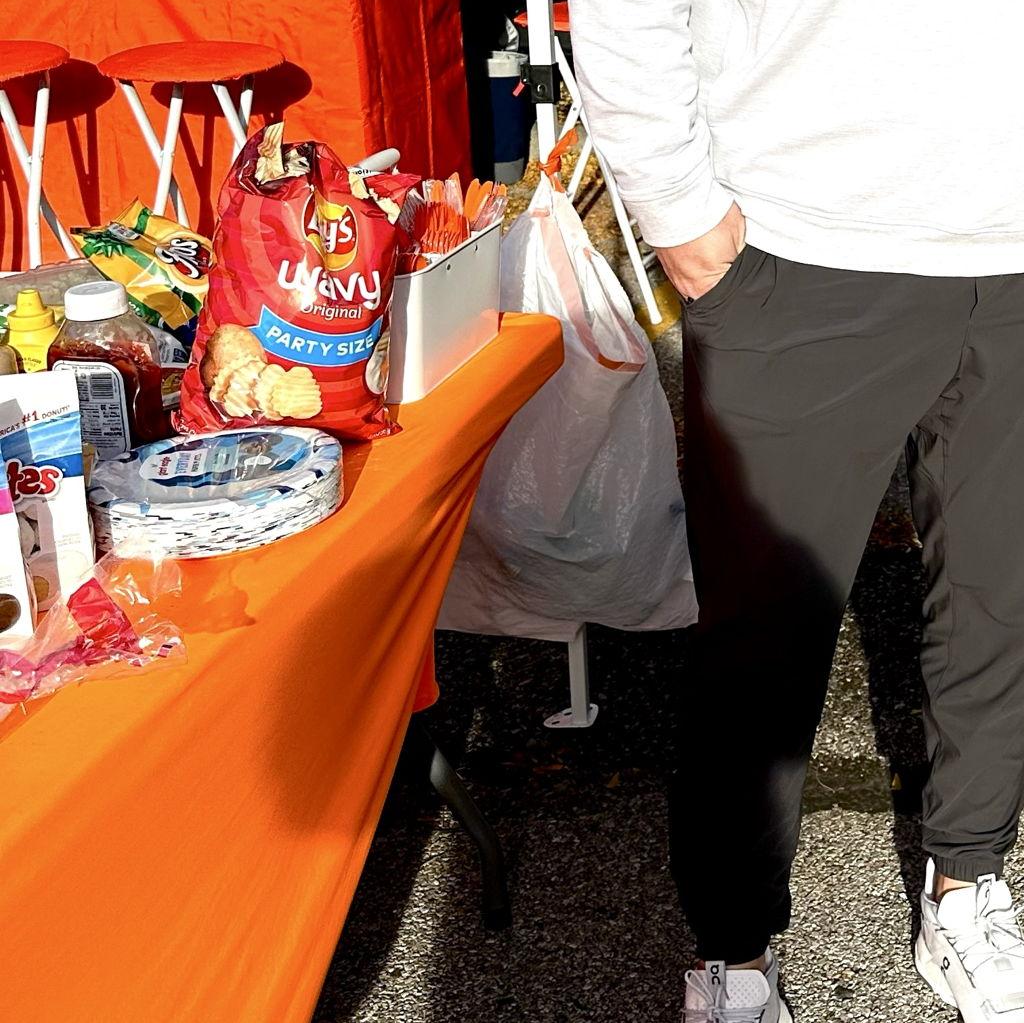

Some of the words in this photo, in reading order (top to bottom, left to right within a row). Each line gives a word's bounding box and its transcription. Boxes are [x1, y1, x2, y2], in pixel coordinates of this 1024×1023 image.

[265, 325, 334, 357] PARTY
[336, 334, 375, 357] SIZE
[7, 460, 60, 502] tes
